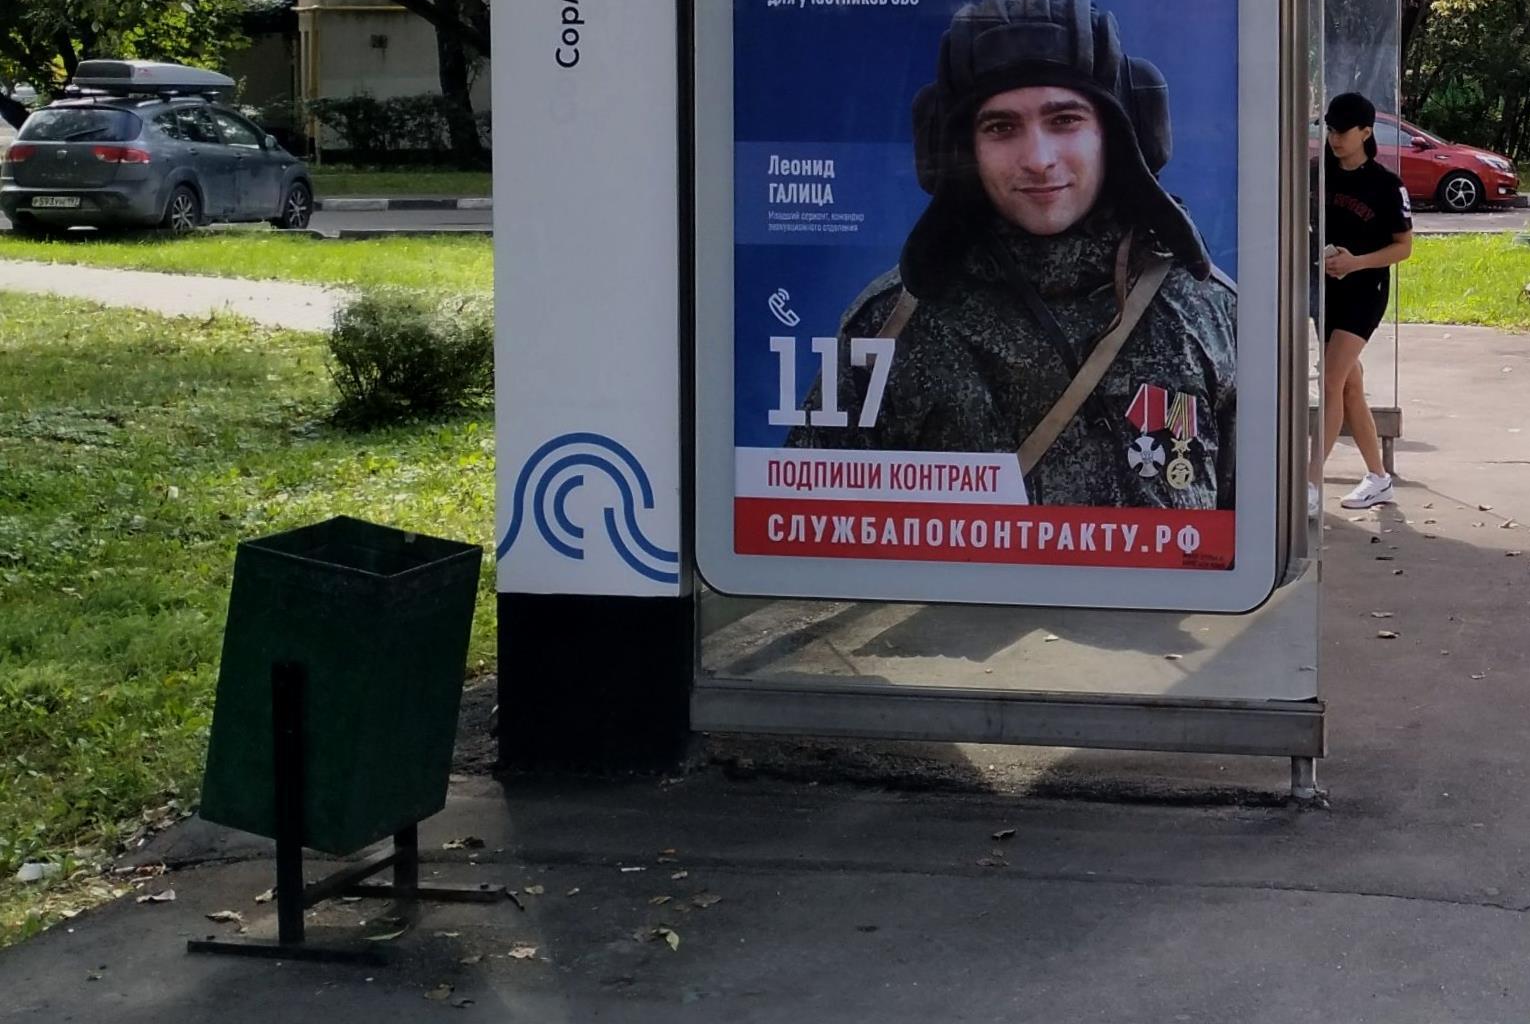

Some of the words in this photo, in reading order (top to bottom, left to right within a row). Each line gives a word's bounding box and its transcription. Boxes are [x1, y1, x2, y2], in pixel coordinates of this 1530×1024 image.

[768, 155, 835, 179] Леонид
[768, 183, 834, 206] ГАЛИЦА
[768, 336, 896, 429] 117
[768, 459, 882, 494] ПОДПИШИ
[890, 462, 1001, 493] КОНТРАКТ
[768, 511, 1201, 556] СЛУЖБАПОКОНТРАКТУ.РФ
